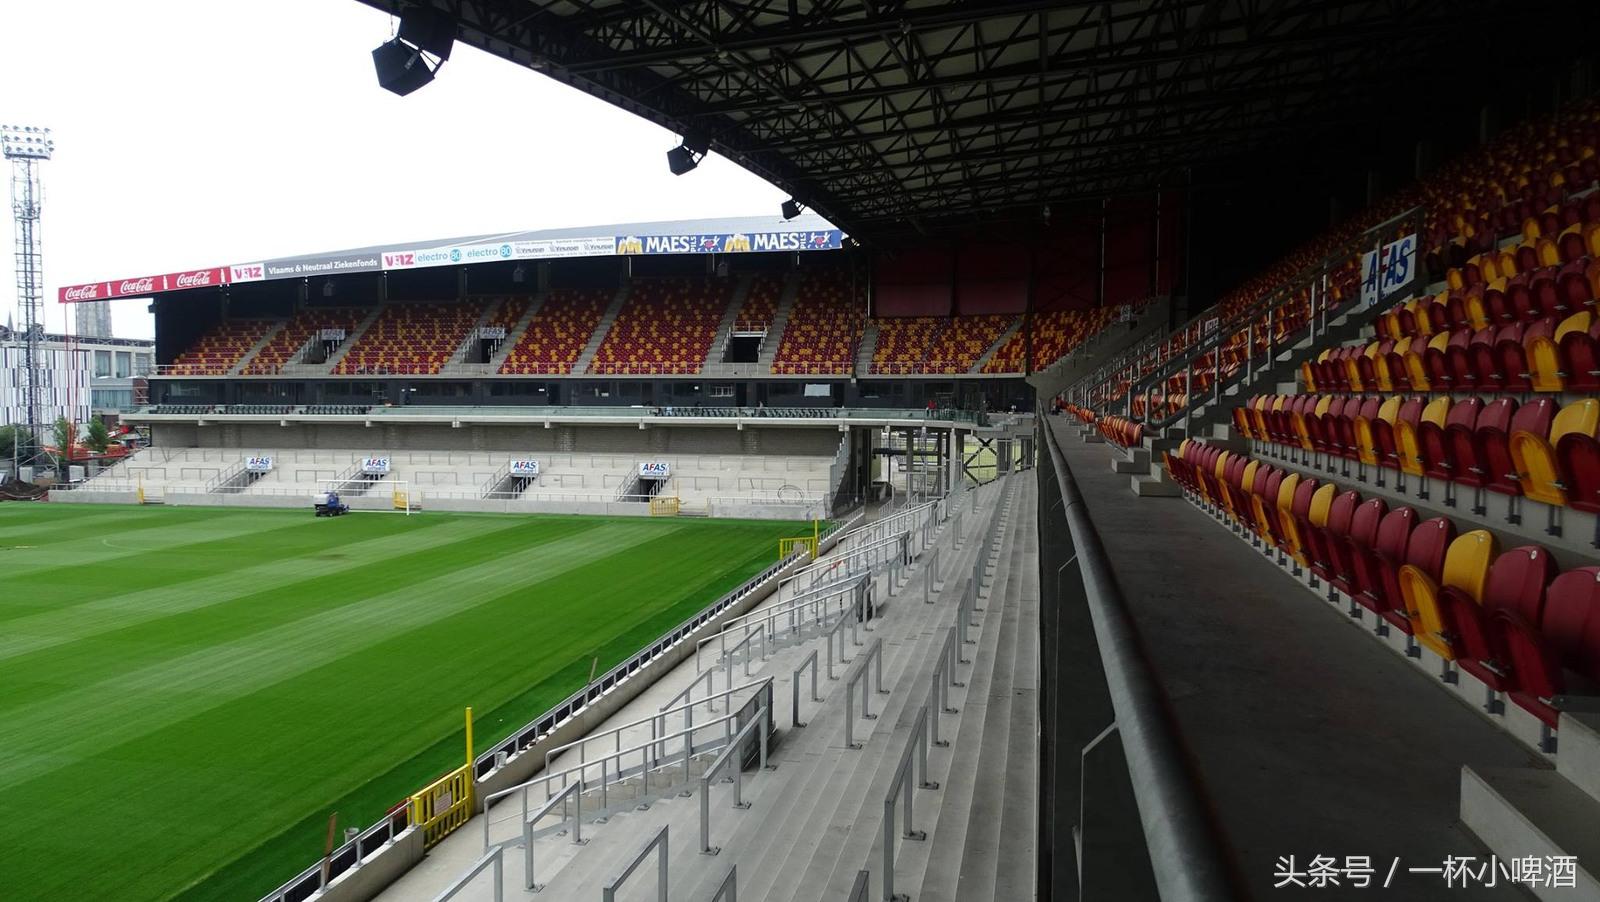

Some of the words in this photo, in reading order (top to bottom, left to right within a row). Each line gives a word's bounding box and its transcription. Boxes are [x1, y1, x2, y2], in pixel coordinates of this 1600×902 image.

[646, 236, 690, 253] MAES
[753, 232, 800, 250] MAES
[418, 252, 448, 262] electro
[467, 247, 498, 258] electro
[268, 266, 294, 275] Vlaams
[295, 264, 301, 272] &
[303, 262, 333, 272] Neutraal
[334, 258, 378, 269] Ziekenfonds
[1365, 239, 1411, 294] AFAS
[249, 457, 269, 465] AFAS
[366, 459, 387, 467] AFAS
[513, 461, 536, 470] AFAS
[643, 463, 666, 471] AFAS
